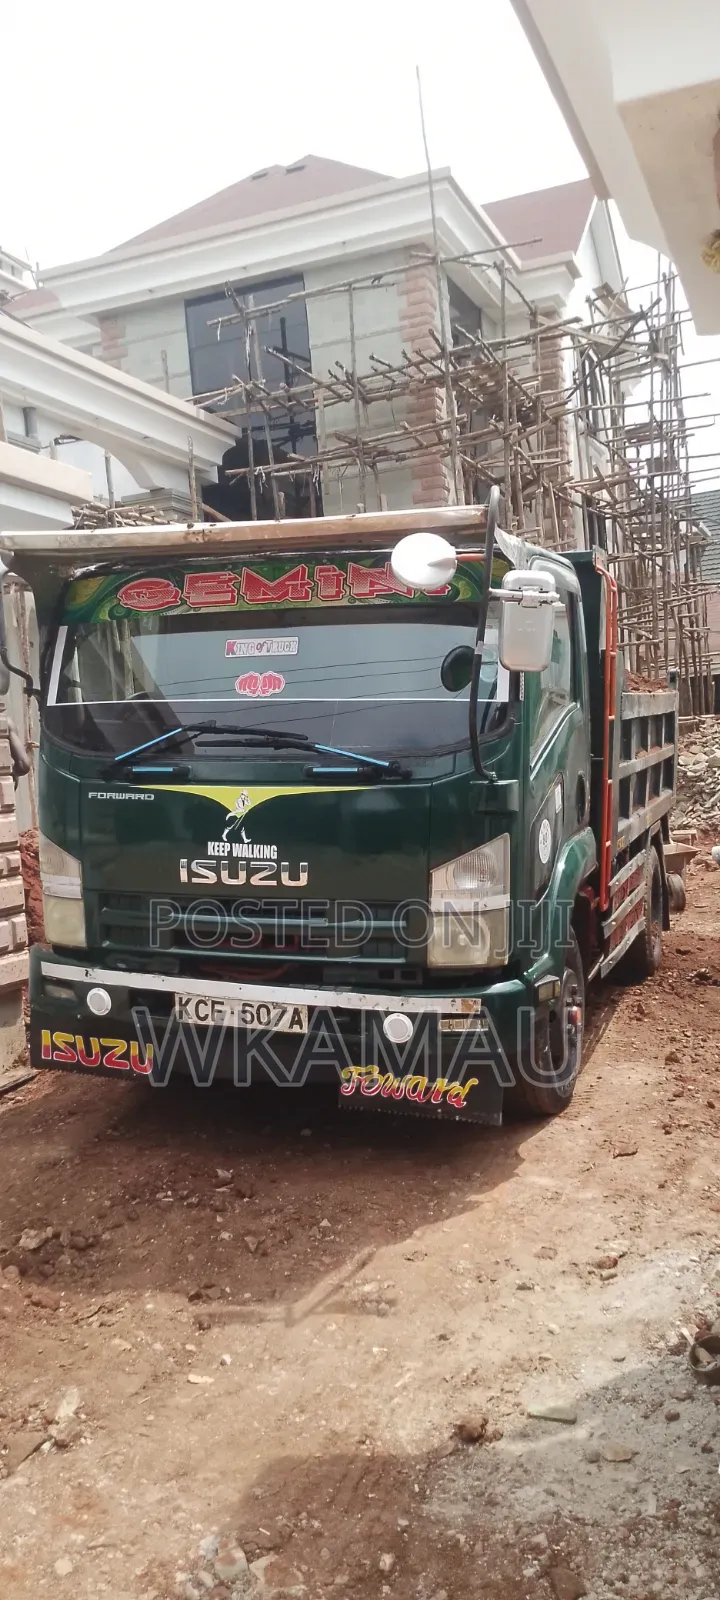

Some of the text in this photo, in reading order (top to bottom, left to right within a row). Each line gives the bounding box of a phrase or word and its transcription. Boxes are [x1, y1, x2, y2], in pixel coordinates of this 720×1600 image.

[117, 562, 451, 612] GEMIN
[226, 641, 255, 656] KING
[265, 640, 298, 653] TRUCK
[88, 791, 155, 801] FORWARD
[207, 841, 278, 860] KEEP WALKING
[179, 858, 309, 887] ISUZU
[178, 996, 304, 1031] KCF 507A
[41, 1029, 154, 1075] ISUZU
